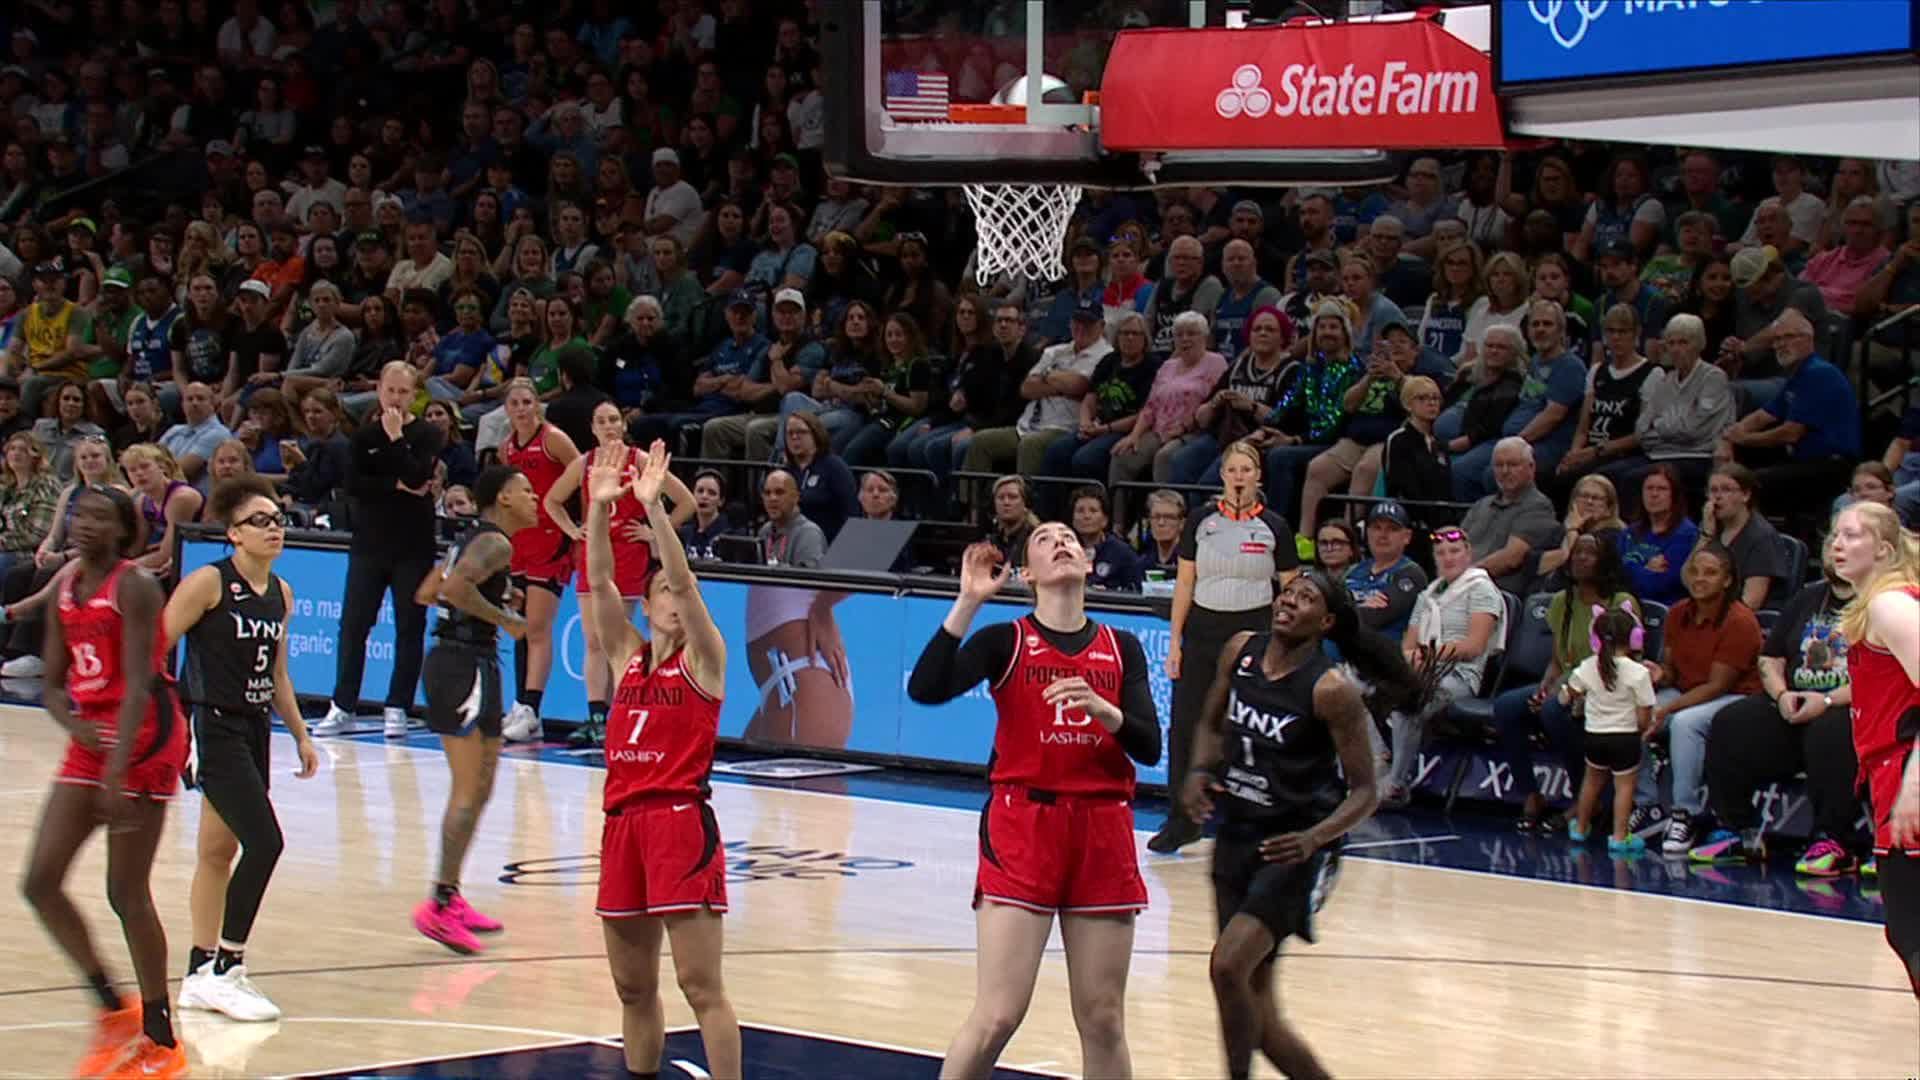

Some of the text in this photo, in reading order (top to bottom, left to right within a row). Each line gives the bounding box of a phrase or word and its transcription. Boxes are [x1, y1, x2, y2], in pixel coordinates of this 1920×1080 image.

[317, 598, 341, 618] ma
[287, 629, 333, 657] ganic
[254, 645, 269, 672] 5
[627, 710, 649, 745] 7
[1228, 688, 1299, 744] LYNX
[1040, 731, 1103, 747] LASHIFY
[1242, 735, 1255, 767] 1
